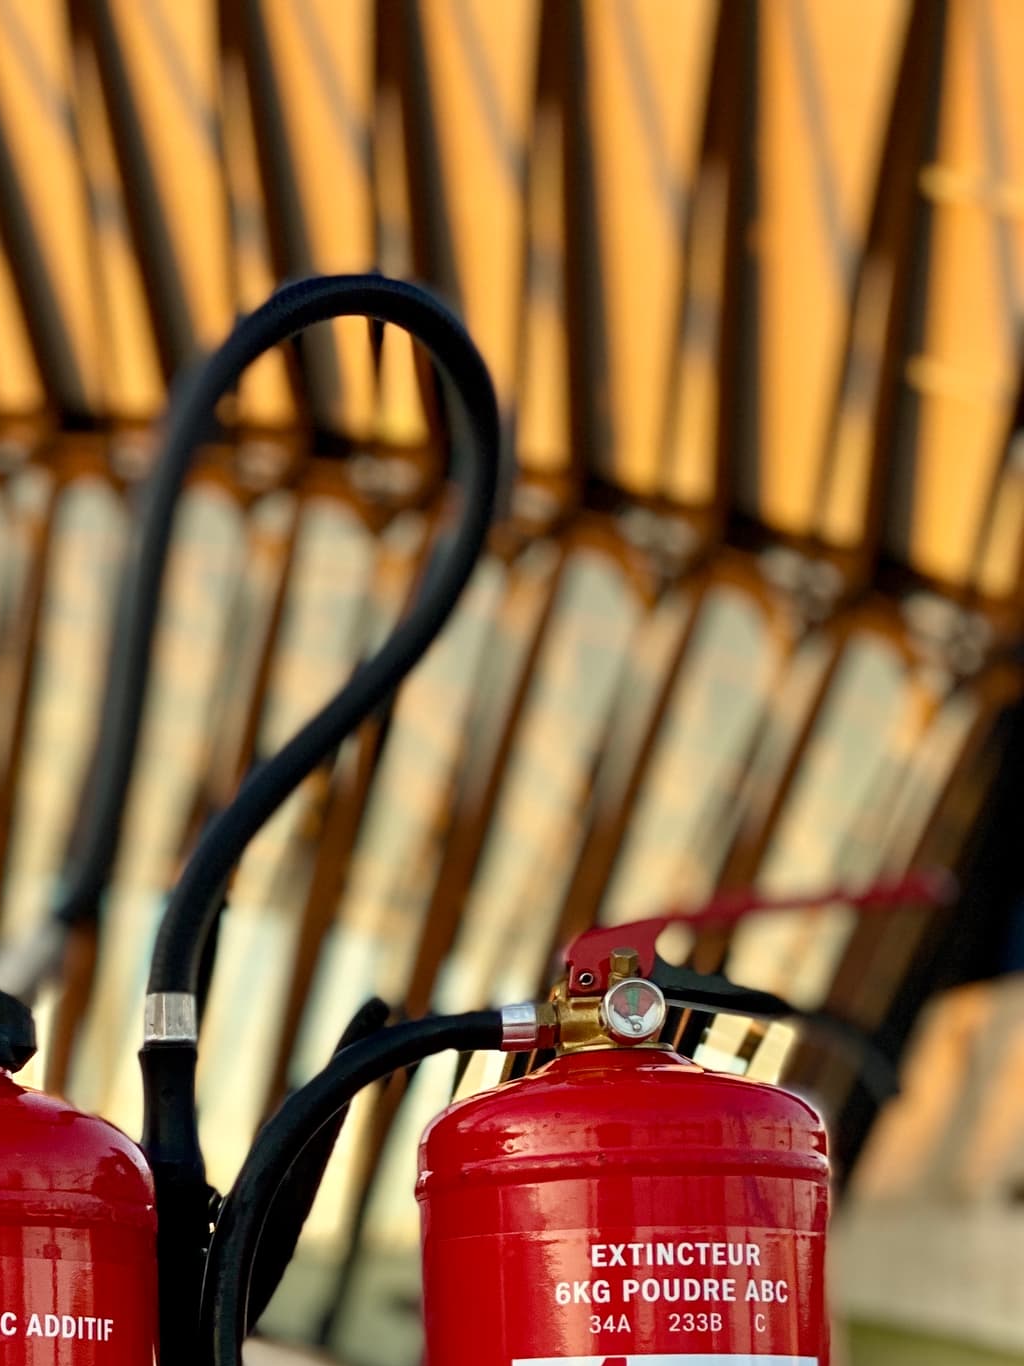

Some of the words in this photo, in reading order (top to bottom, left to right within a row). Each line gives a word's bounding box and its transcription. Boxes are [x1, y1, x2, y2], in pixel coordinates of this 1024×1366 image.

[591, 1242, 761, 1268] EXTINCTEUR
[553, 1280, 611, 1305] 6KG
[622, 1278, 737, 1303] POUDRE
[744, 1279, 788, 1303] ABC
[26, 1312, 114, 1341] ADDITIF
[588, 1313, 632, 1333] 34A
[668, 1312, 723, 1332] 233B
[754, 1313, 766, 1333] C
